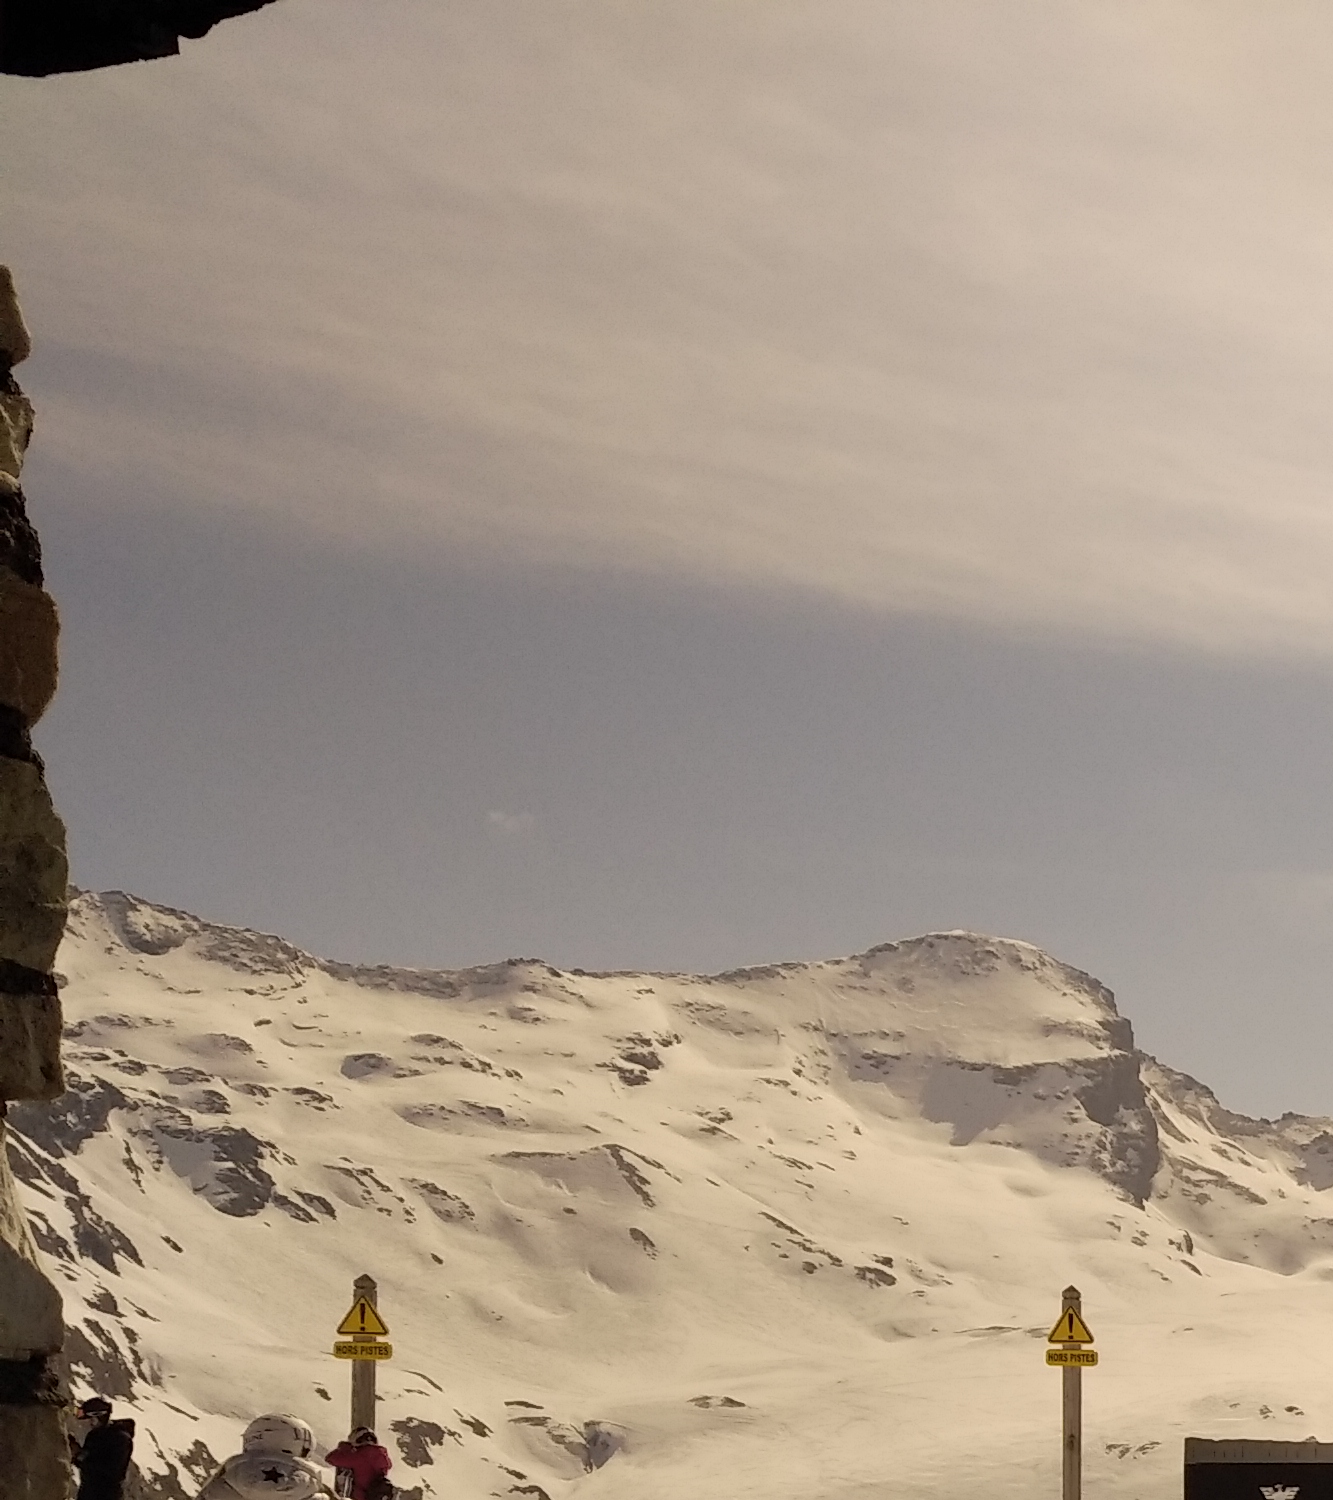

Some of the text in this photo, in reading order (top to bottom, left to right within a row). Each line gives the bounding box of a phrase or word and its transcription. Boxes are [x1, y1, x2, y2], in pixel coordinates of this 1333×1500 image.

[335, 1345, 389, 1356] HORS PISTES
[1048, 1352, 1095, 1363] HORS PISTES
